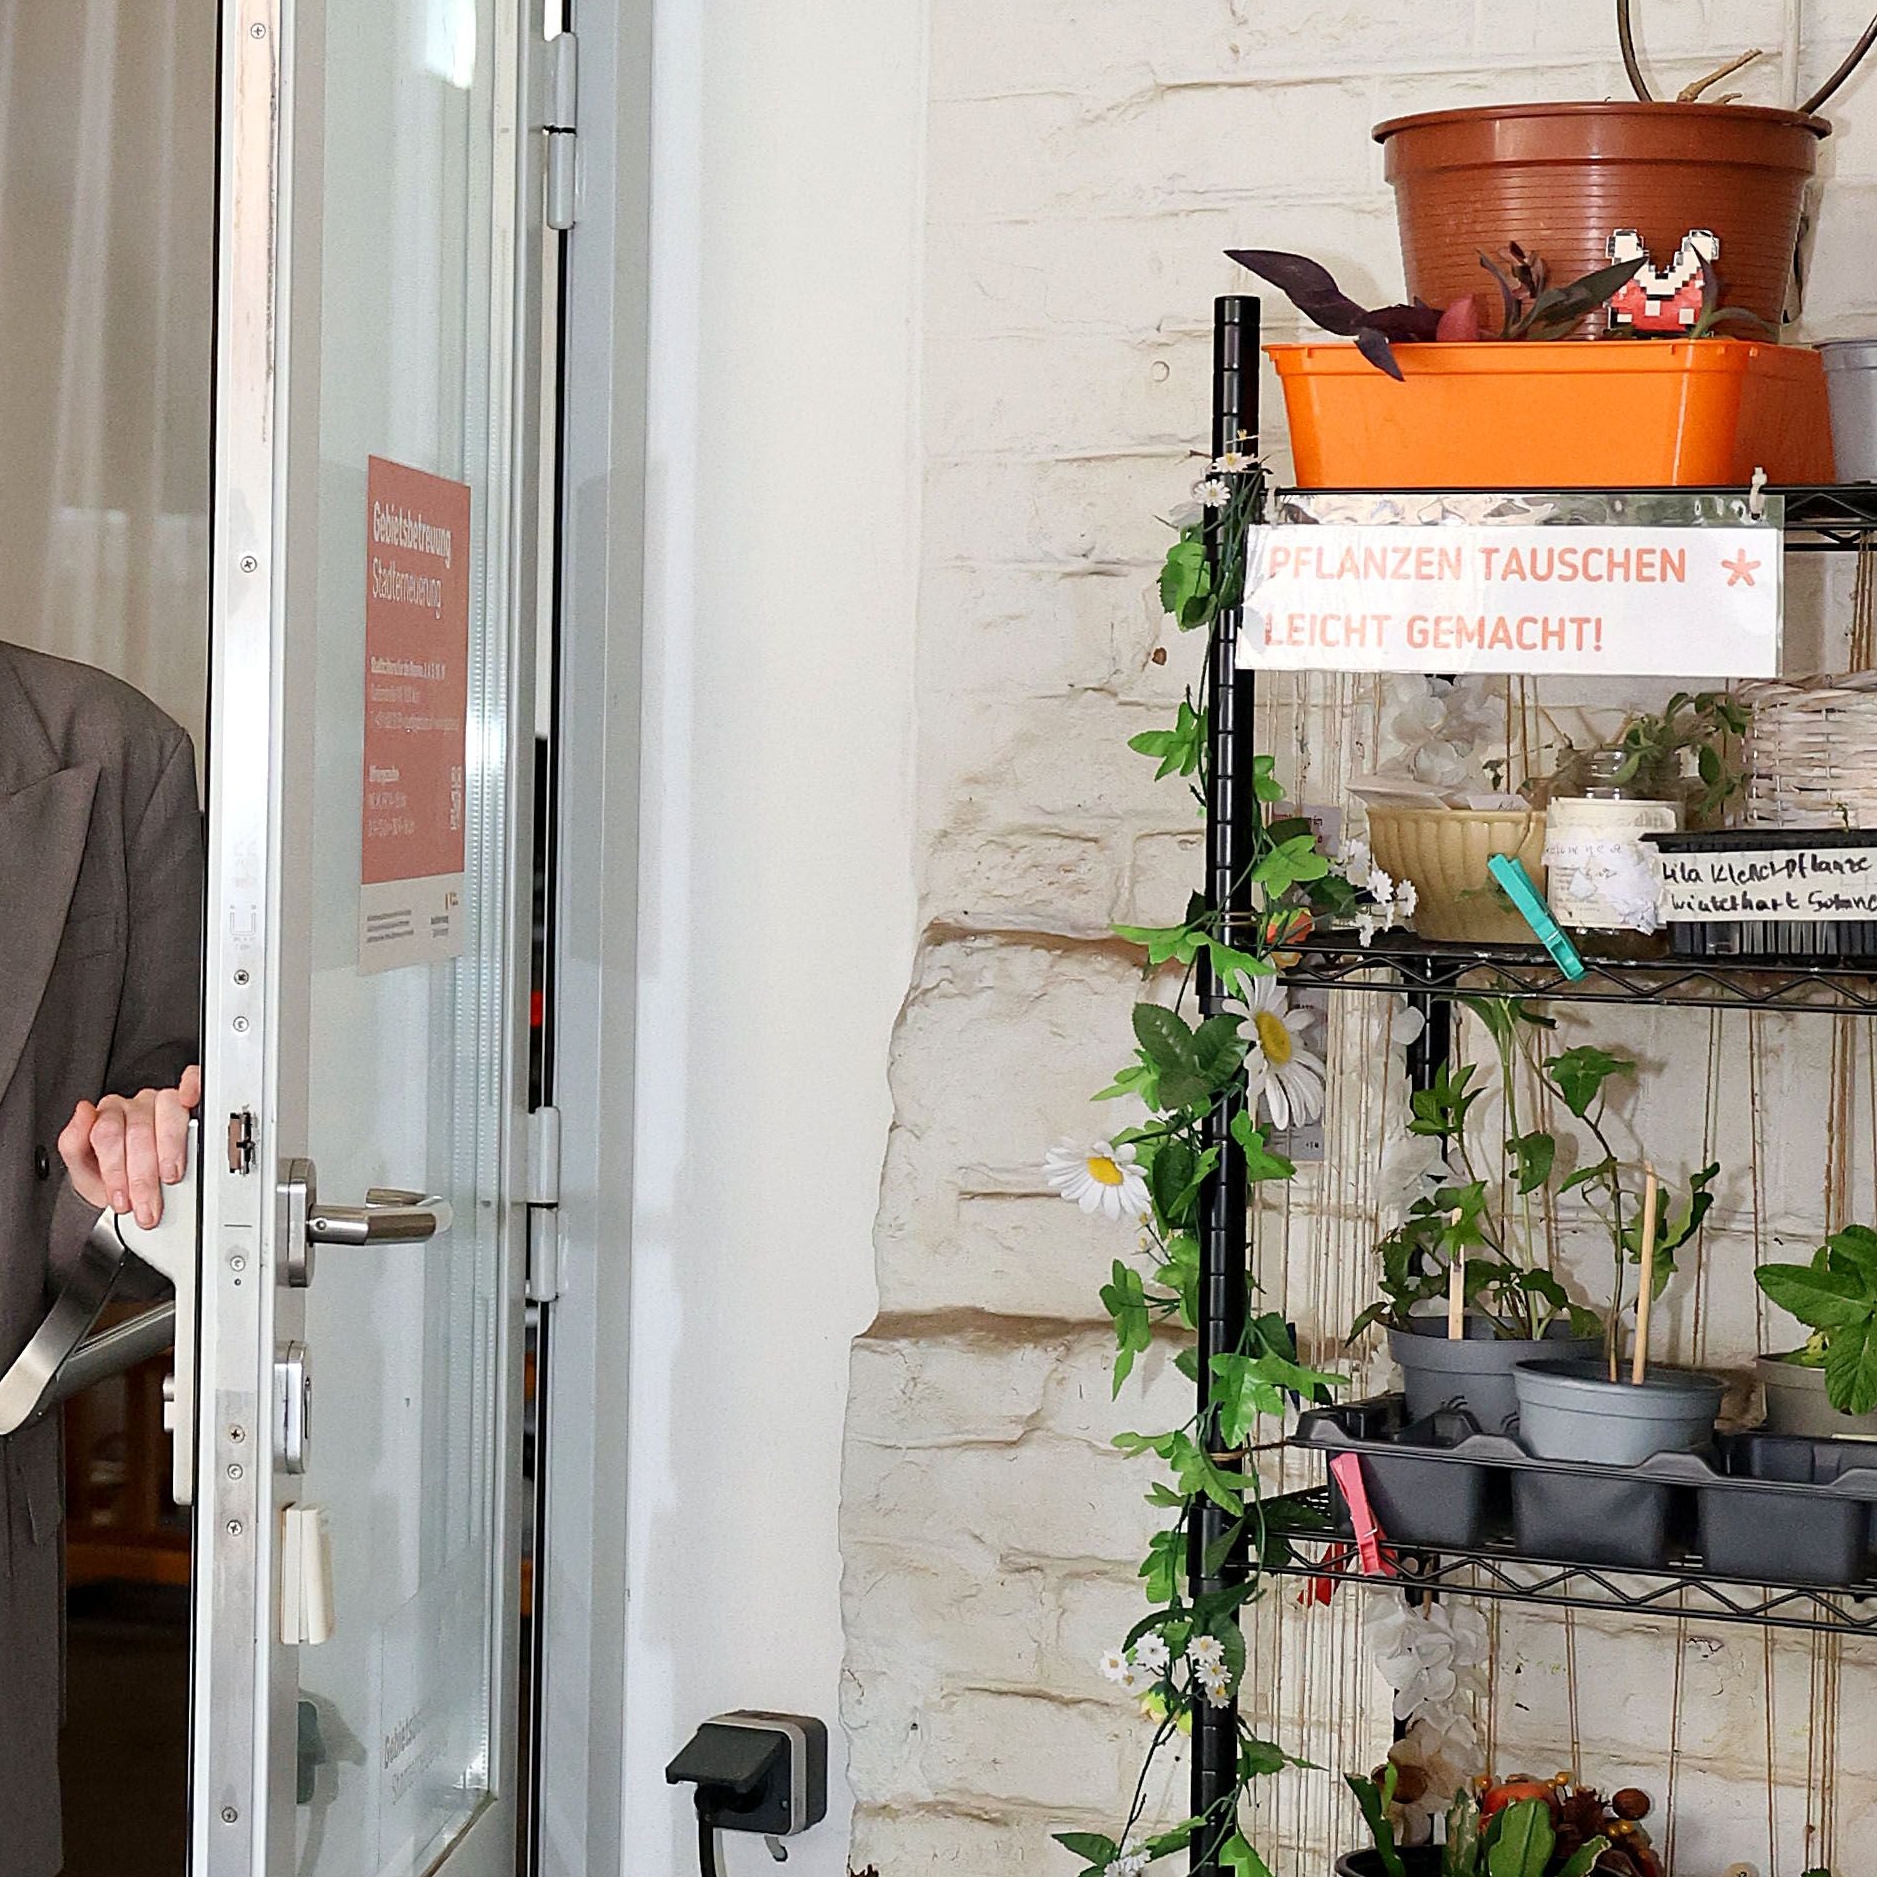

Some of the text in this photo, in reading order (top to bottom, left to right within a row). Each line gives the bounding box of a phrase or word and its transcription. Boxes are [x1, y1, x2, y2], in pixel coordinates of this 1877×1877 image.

[373, 500, 451, 569] Gebietsbetreuung
[1268, 545, 1686, 582] PFLANZEN TAUSCHEN
[372, 556, 442, 619] Stadterneuerung
[1263, 612, 1603, 652] LEICHT GEMACHT!
[1662, 862, 1703, 884] Lila
